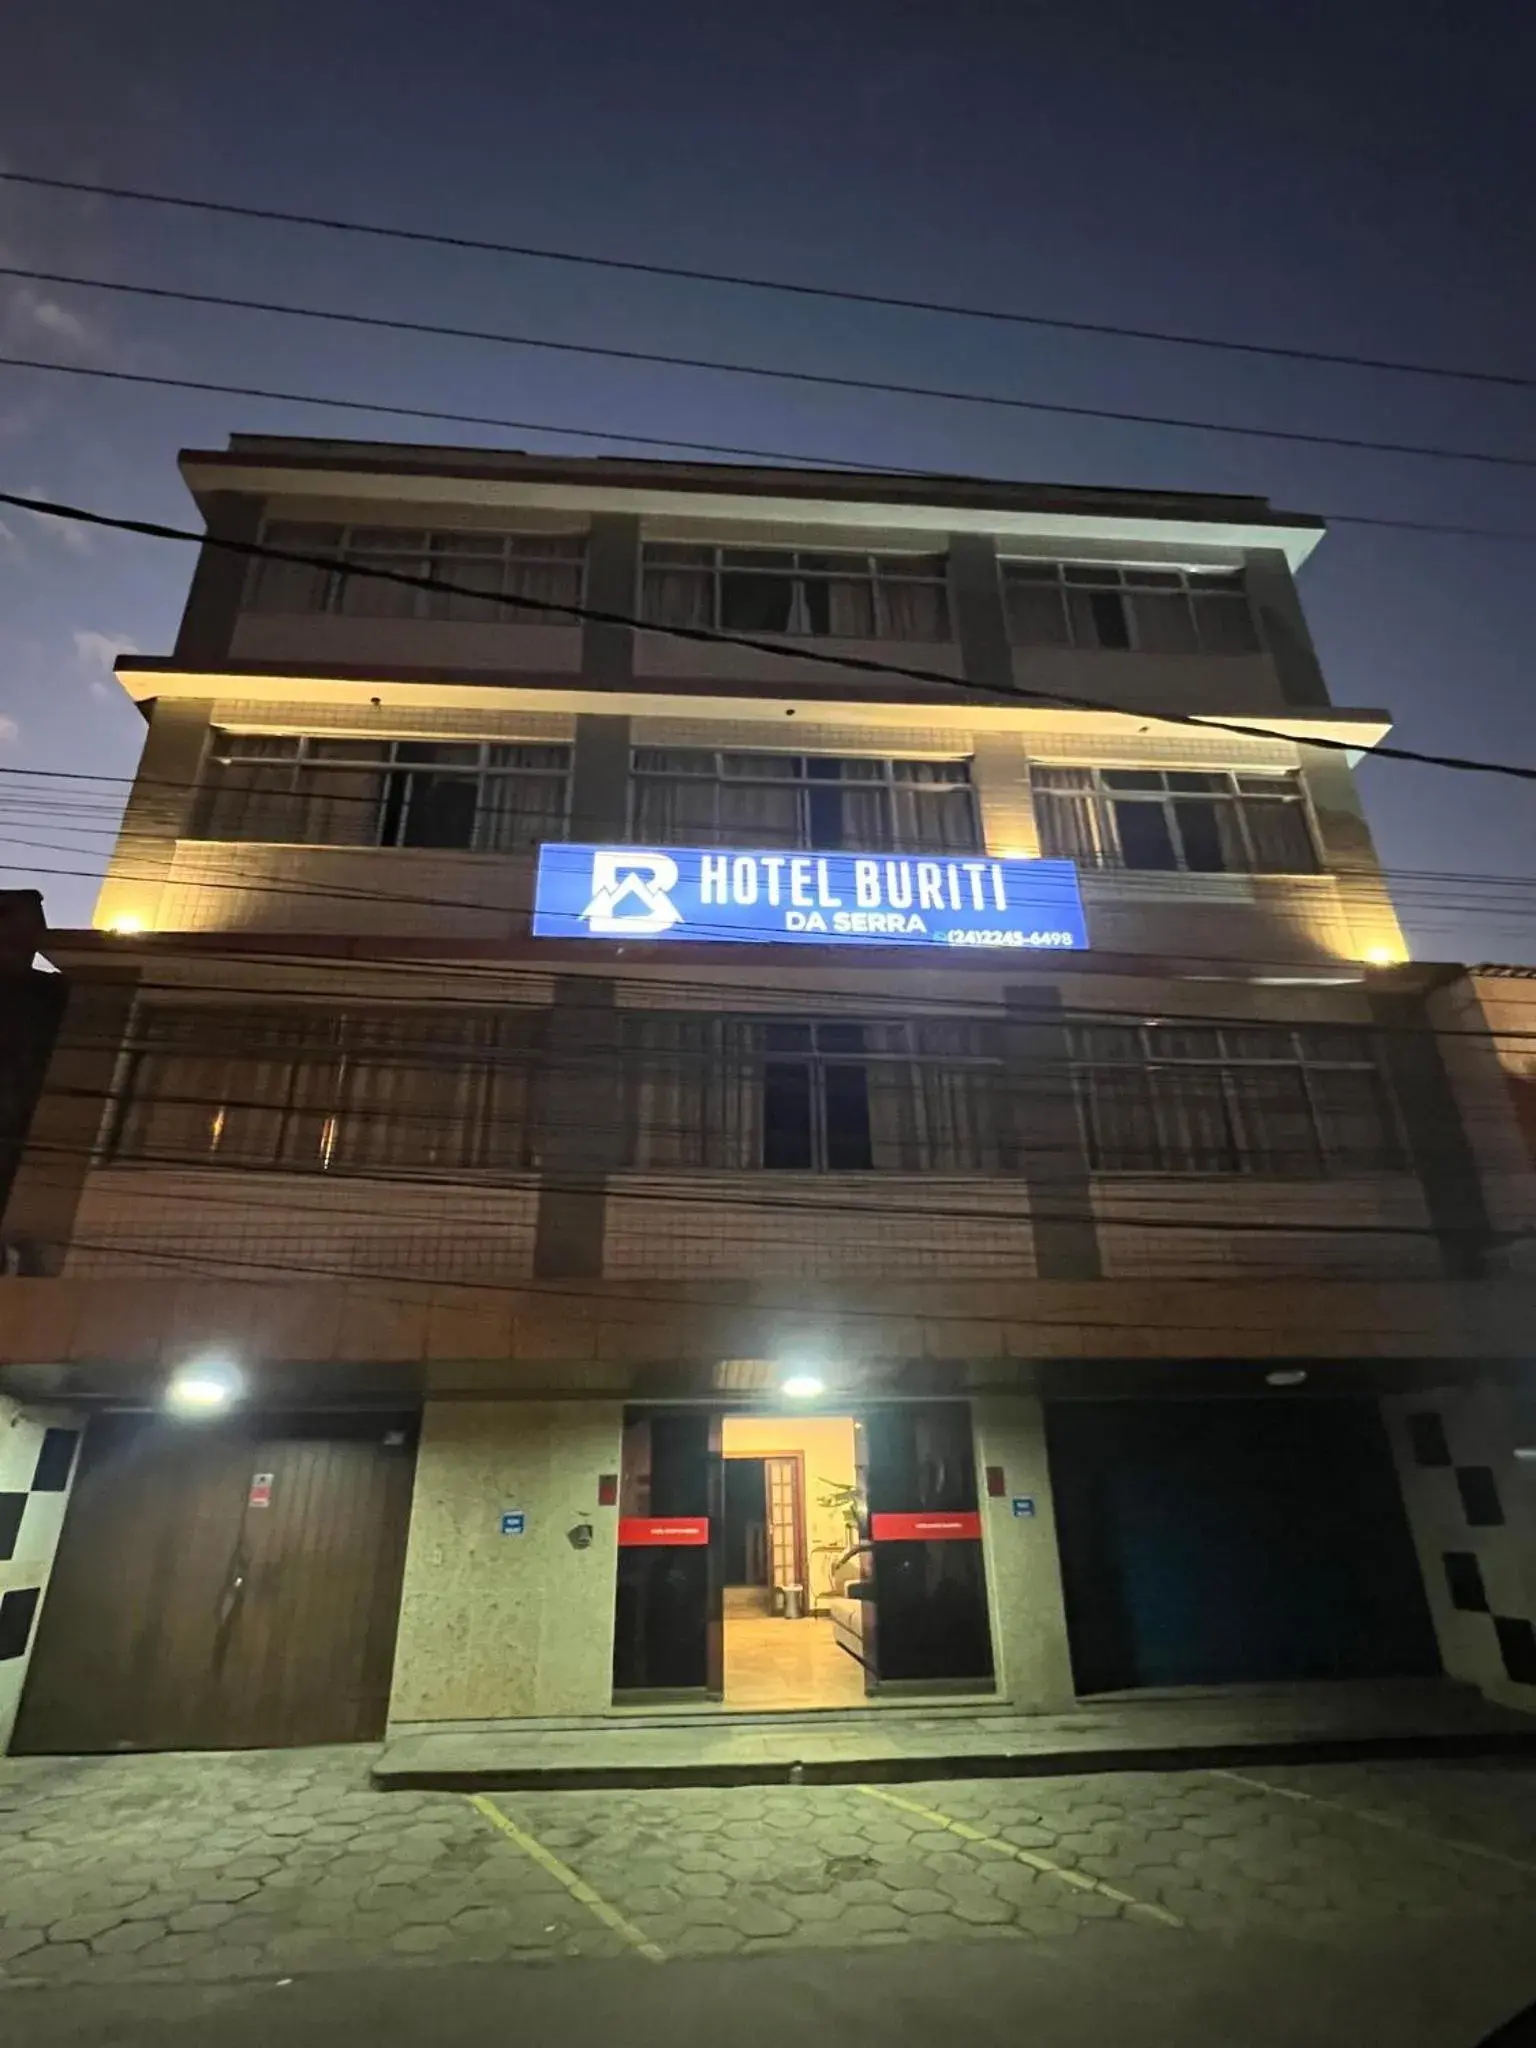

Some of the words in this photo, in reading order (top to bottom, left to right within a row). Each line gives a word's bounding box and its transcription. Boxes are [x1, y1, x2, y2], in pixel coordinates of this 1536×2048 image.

[700, 856, 842, 907] HOTEL
[855, 859, 1007, 911] BURITI
[785, 911, 827, 931] DA
[833, 912, 927, 934] SERRA
